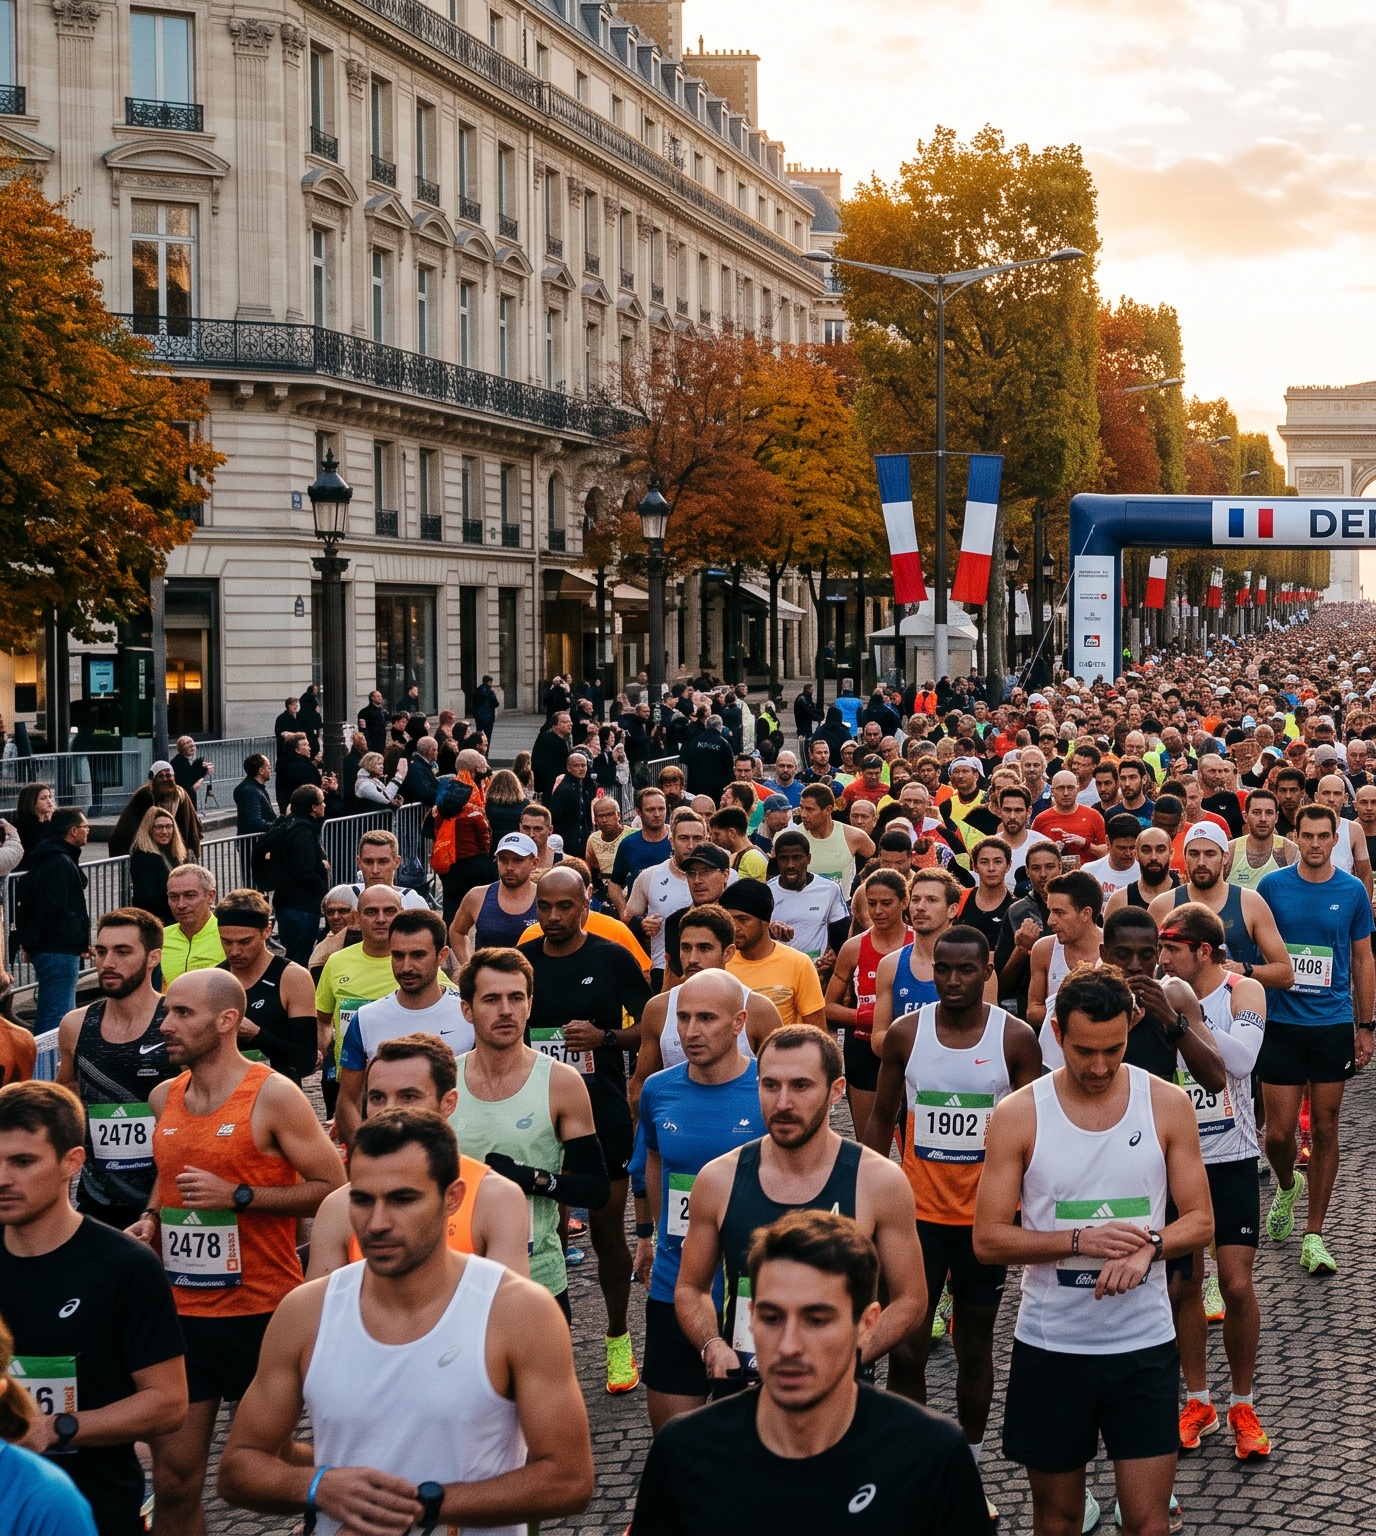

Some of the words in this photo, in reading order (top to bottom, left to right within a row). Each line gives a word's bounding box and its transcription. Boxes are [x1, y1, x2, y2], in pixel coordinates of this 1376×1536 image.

[98, 1122, 147, 1146] 2478
[927, 1112, 978, 1137] 1902
[168, 1230, 222, 1259] 2478
